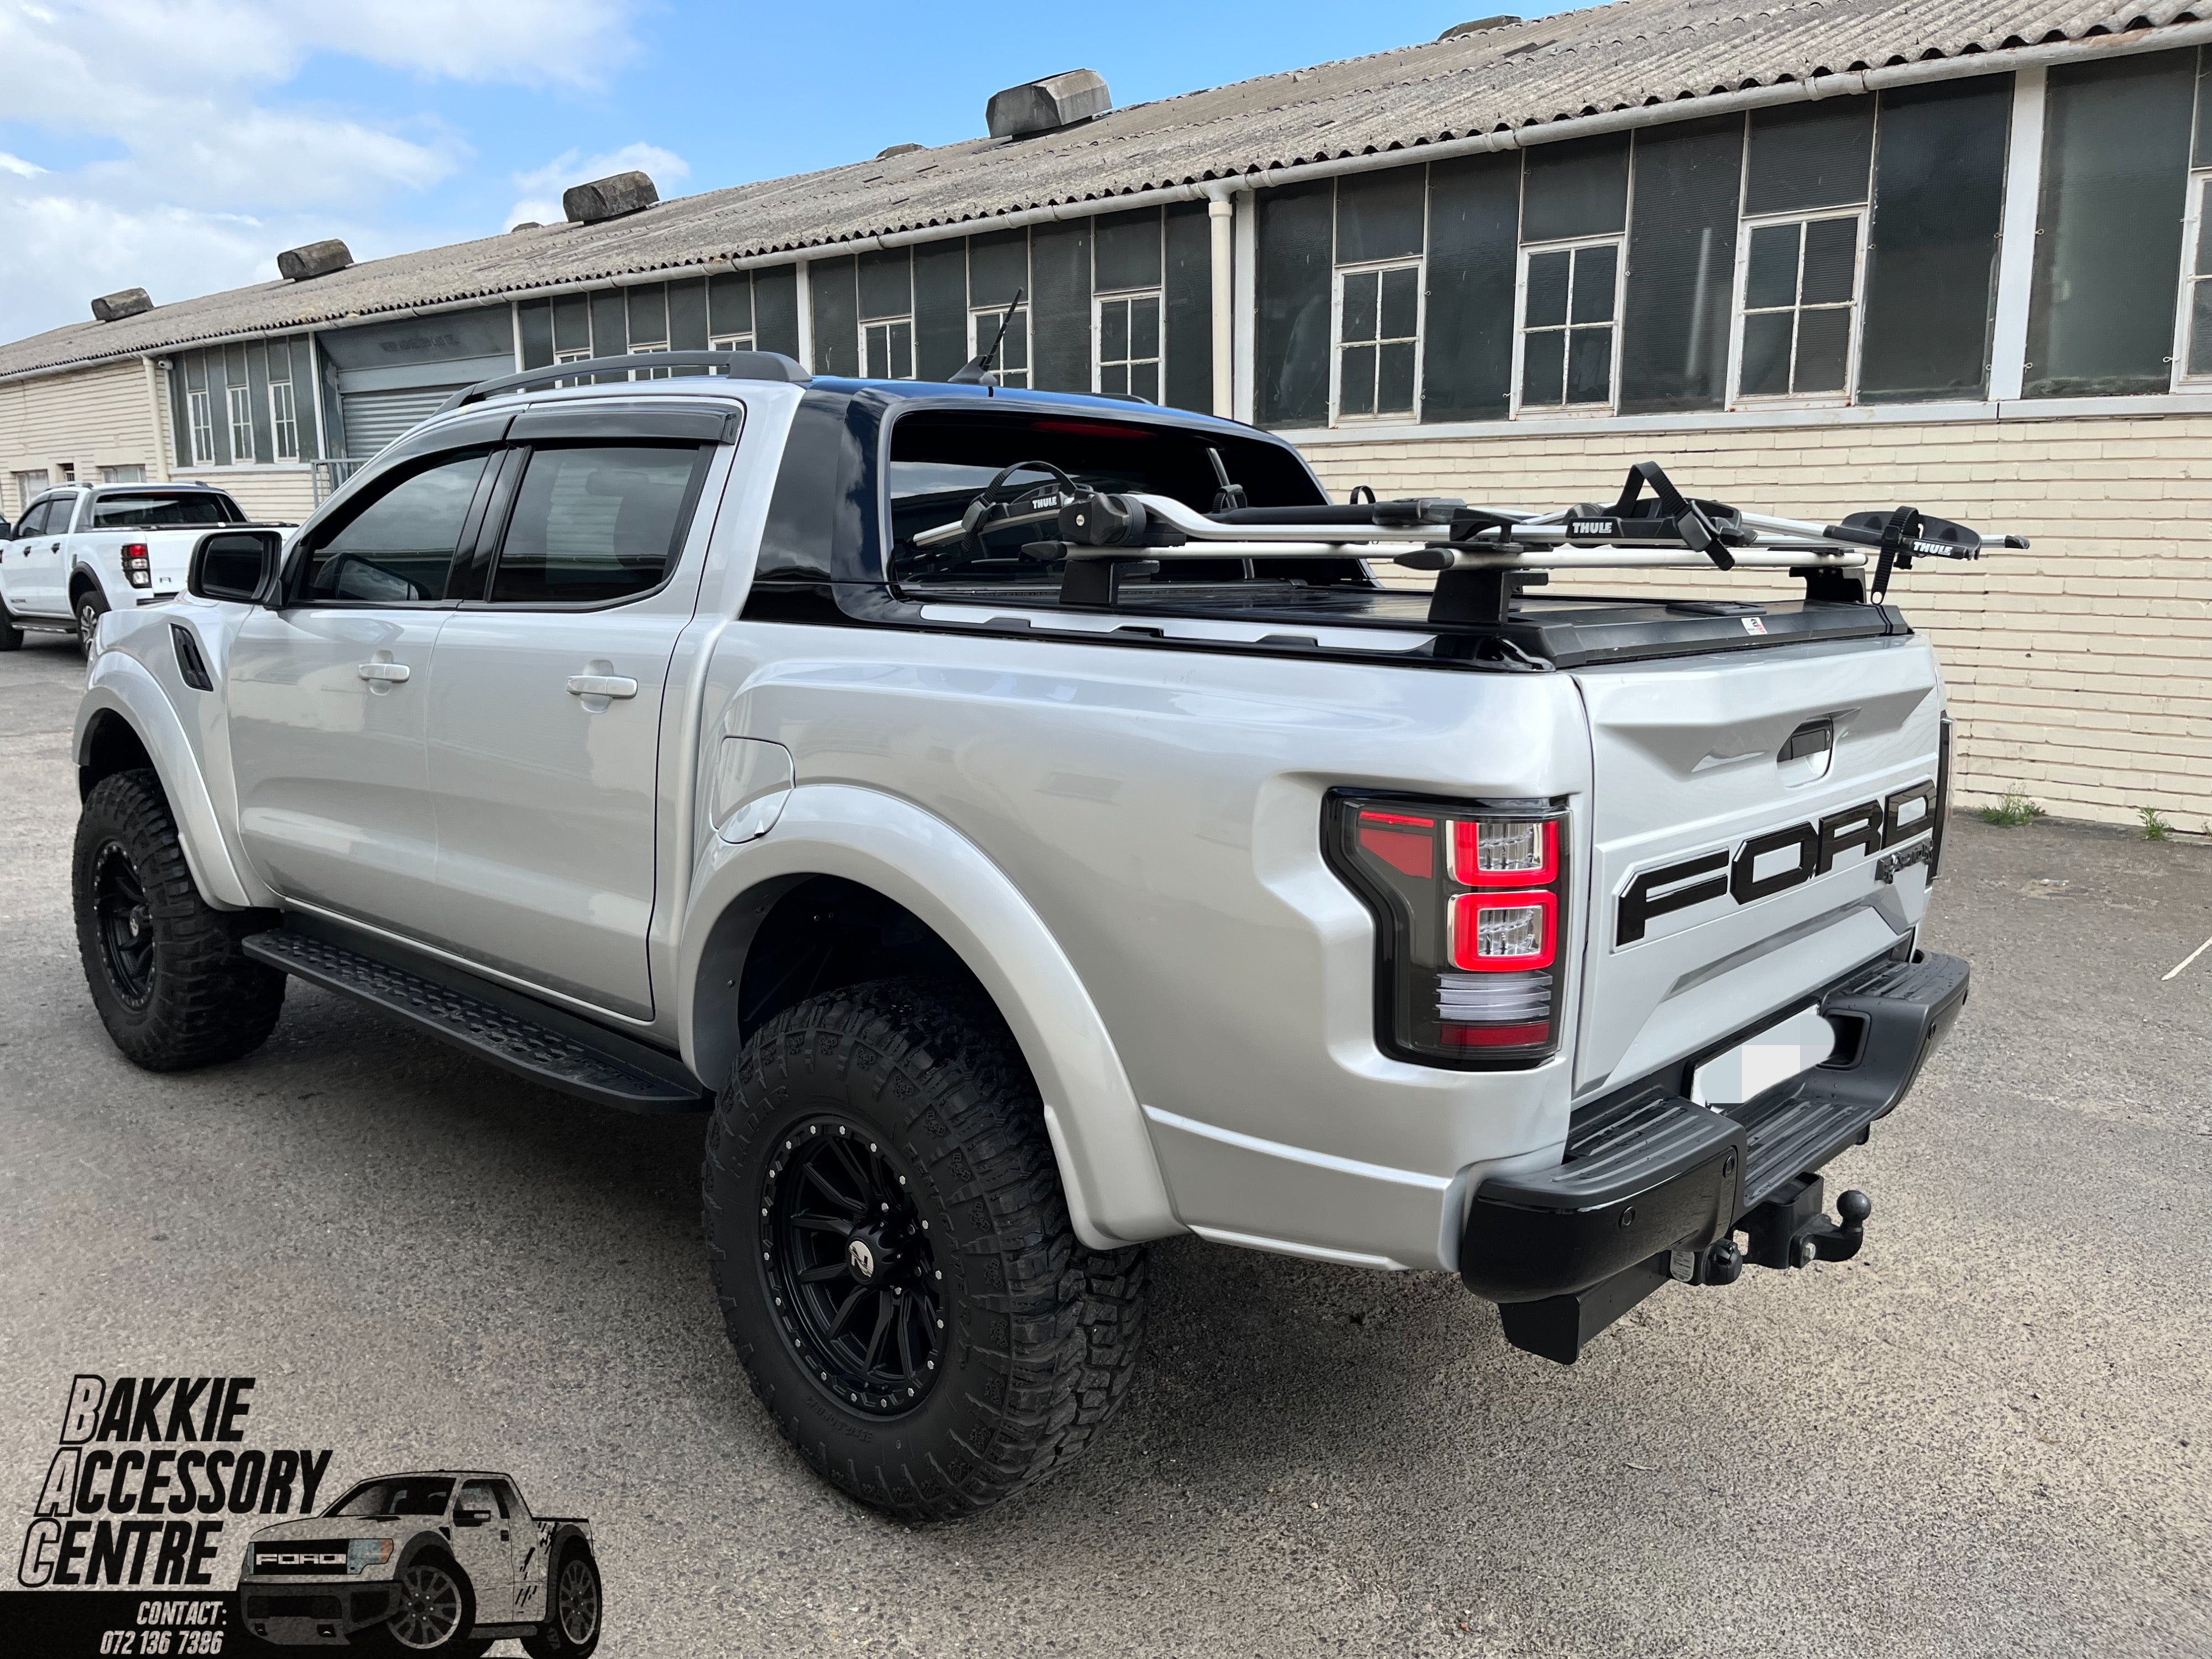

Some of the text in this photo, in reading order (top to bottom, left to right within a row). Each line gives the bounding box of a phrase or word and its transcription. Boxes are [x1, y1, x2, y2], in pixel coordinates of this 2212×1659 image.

[1032, 496, 1057, 509] THULE
[1572, 522, 1613, 534] THULE
[1913, 541, 1953, 556] THULE
[1618, 778, 1936, 947] FORD
[729, 1084, 790, 1180] RADAR
